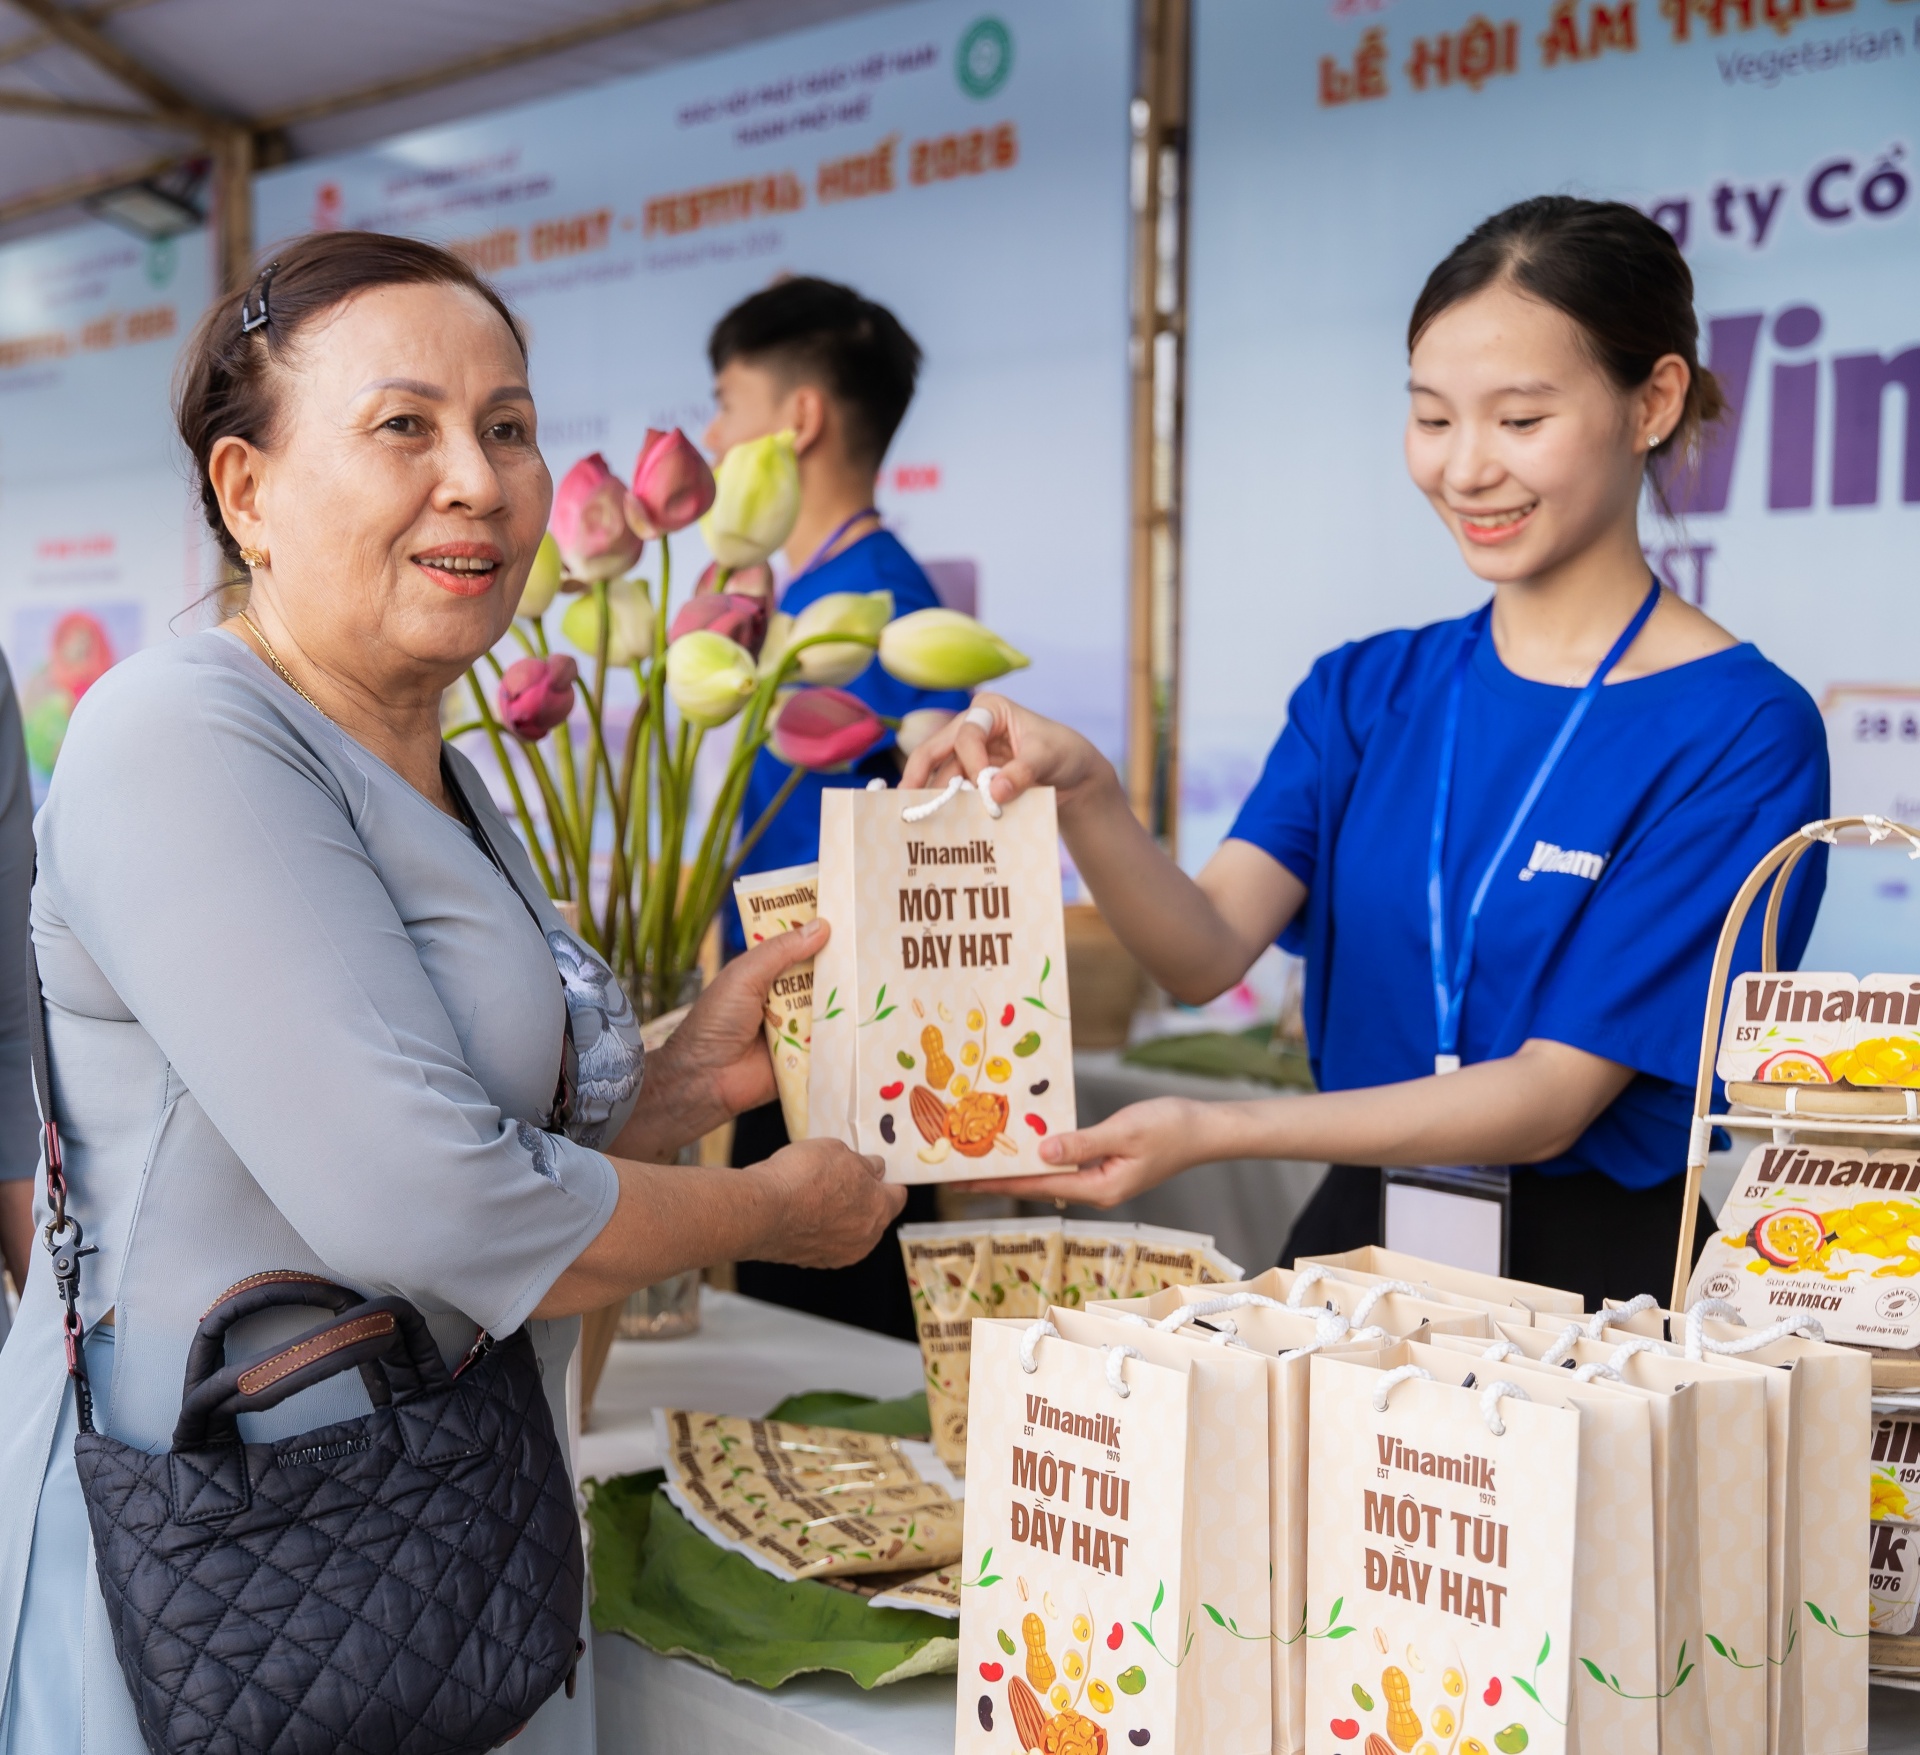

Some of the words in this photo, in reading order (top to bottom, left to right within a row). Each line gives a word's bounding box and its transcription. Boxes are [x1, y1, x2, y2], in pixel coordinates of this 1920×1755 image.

[1406, 13, 1520, 92] HỘI
[1714, 184, 1783, 246] ty
[906, 840, 996, 865] Vinamilk
[749, 887, 817, 914] Vinamilk
[899, 882, 957, 927] MỘT
[963, 881, 1011, 920] TÚI
[901, 926, 952, 970] ĐẦY
[959, 933, 1012, 972] HẠT
[1736, 1027, 1761, 1041] EST
[1744, 1186, 1769, 1199] EST
[1023, 1425, 1034, 1437] EST
[1026, 1393, 1121, 1449] Vinamilk
[276, 1452, 301, 1469] MZ
[1106, 1449, 1120, 1462] 1976
[1376, 1433, 1496, 1492] Vinamilk
[1377, 1467, 1389, 1480] EST
[1012, 1445, 1076, 1503] MỘT
[1081, 1466, 1131, 1522] TÚI
[1479, 1492, 1496, 1506] 1976
[1010, 1498, 1066, 1556] ĐẦY
[1071, 1520, 1129, 1577] HẠT
[1363, 1489, 1443, 1549] MỘT
[1450, 1511, 1509, 1569] TÚI
[1363, 1544, 1433, 1605] ĐẦY
[1440, 1568, 1508, 1629] HẠT
[1869, 1574, 1902, 1593] 1976
